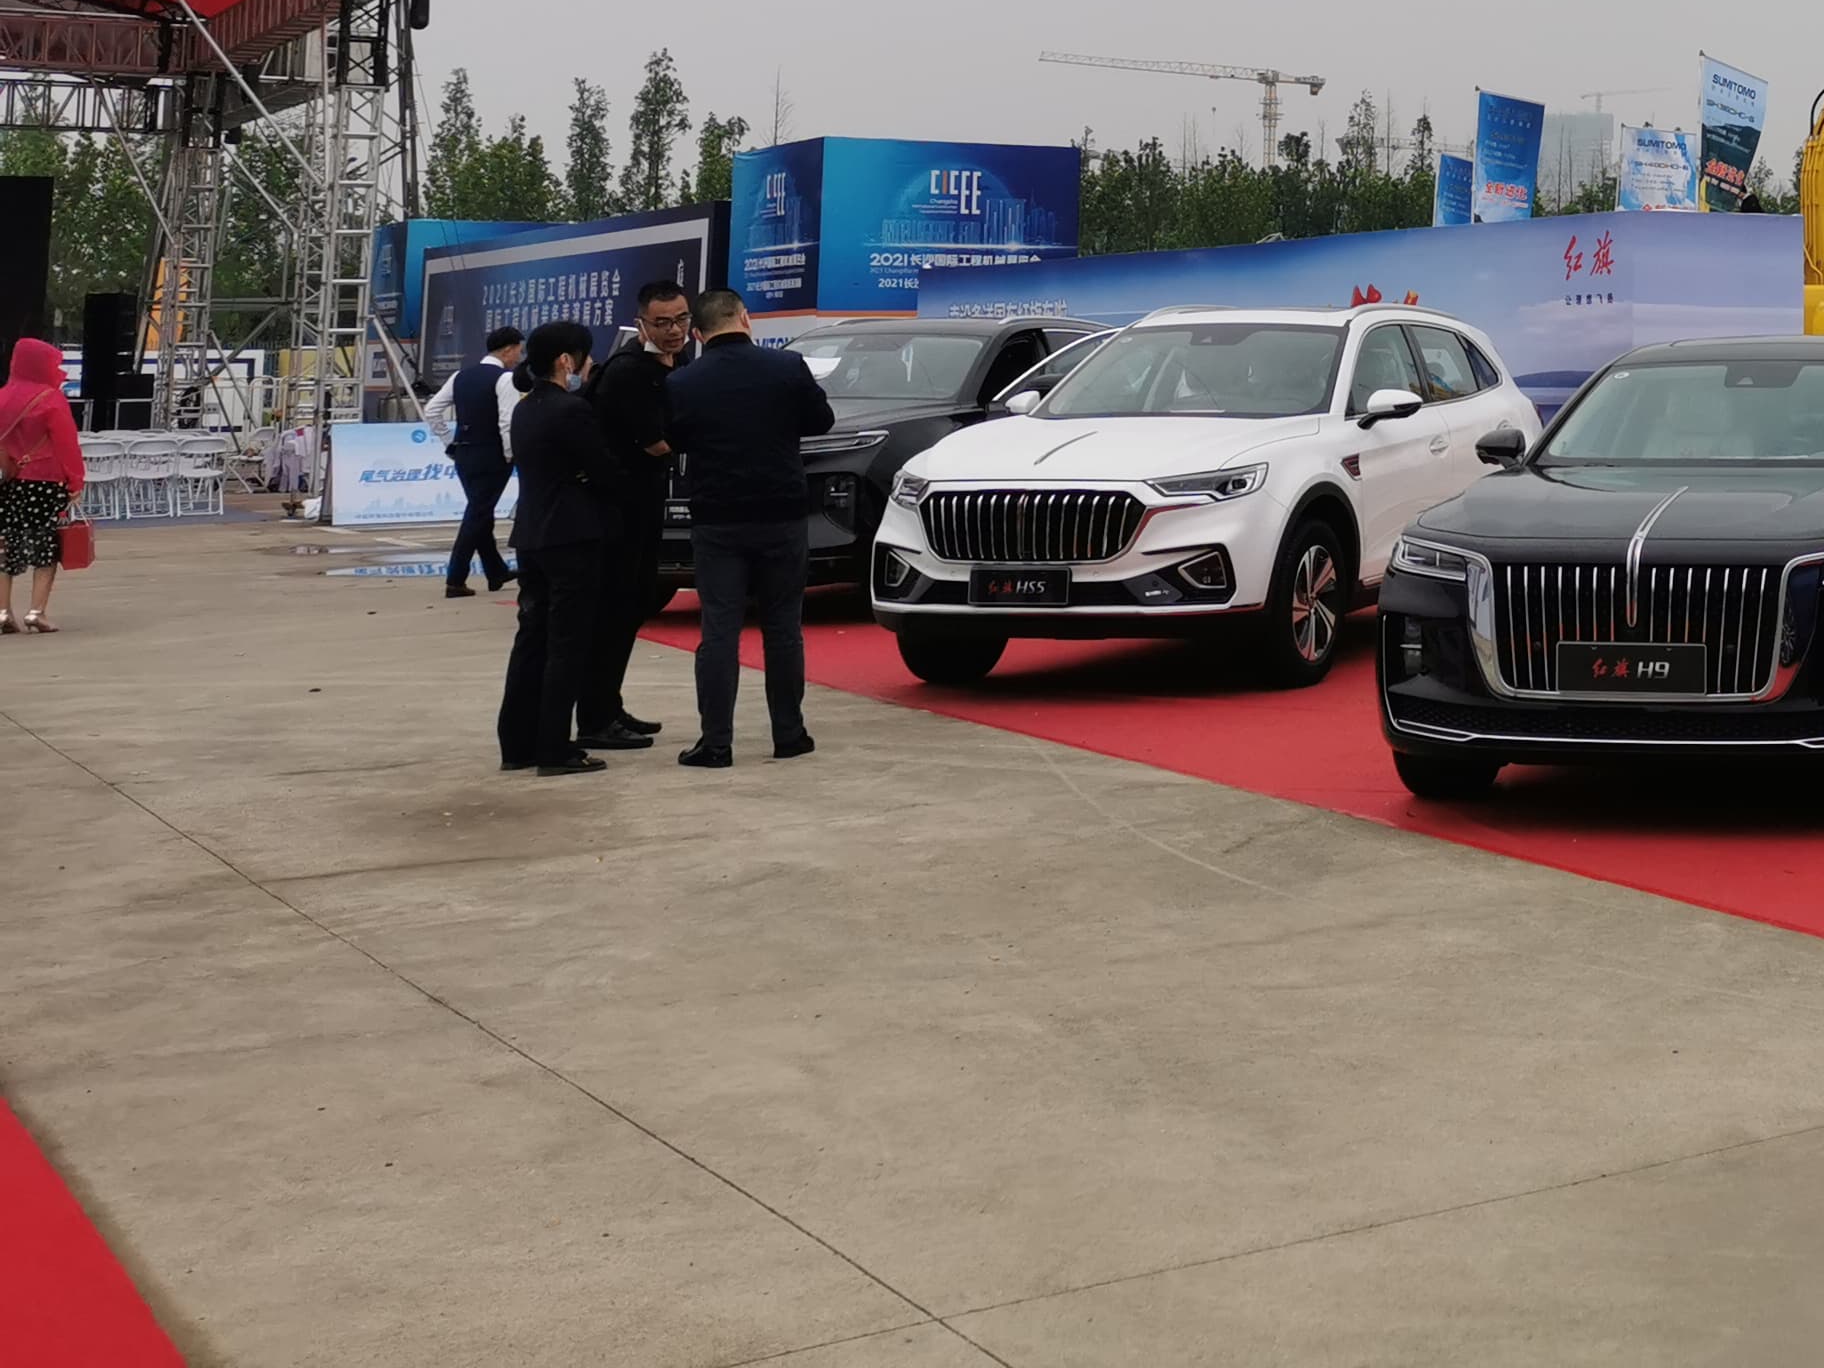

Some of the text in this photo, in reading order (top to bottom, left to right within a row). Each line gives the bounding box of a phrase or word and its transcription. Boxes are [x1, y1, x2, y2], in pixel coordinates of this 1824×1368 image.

[1712, 73, 1757, 100] SUMITOMO
[1564, 230, 1615, 280] 红旗
[1016, 580, 1046, 594] HS5
[1637, 661, 1670, 679] H9
